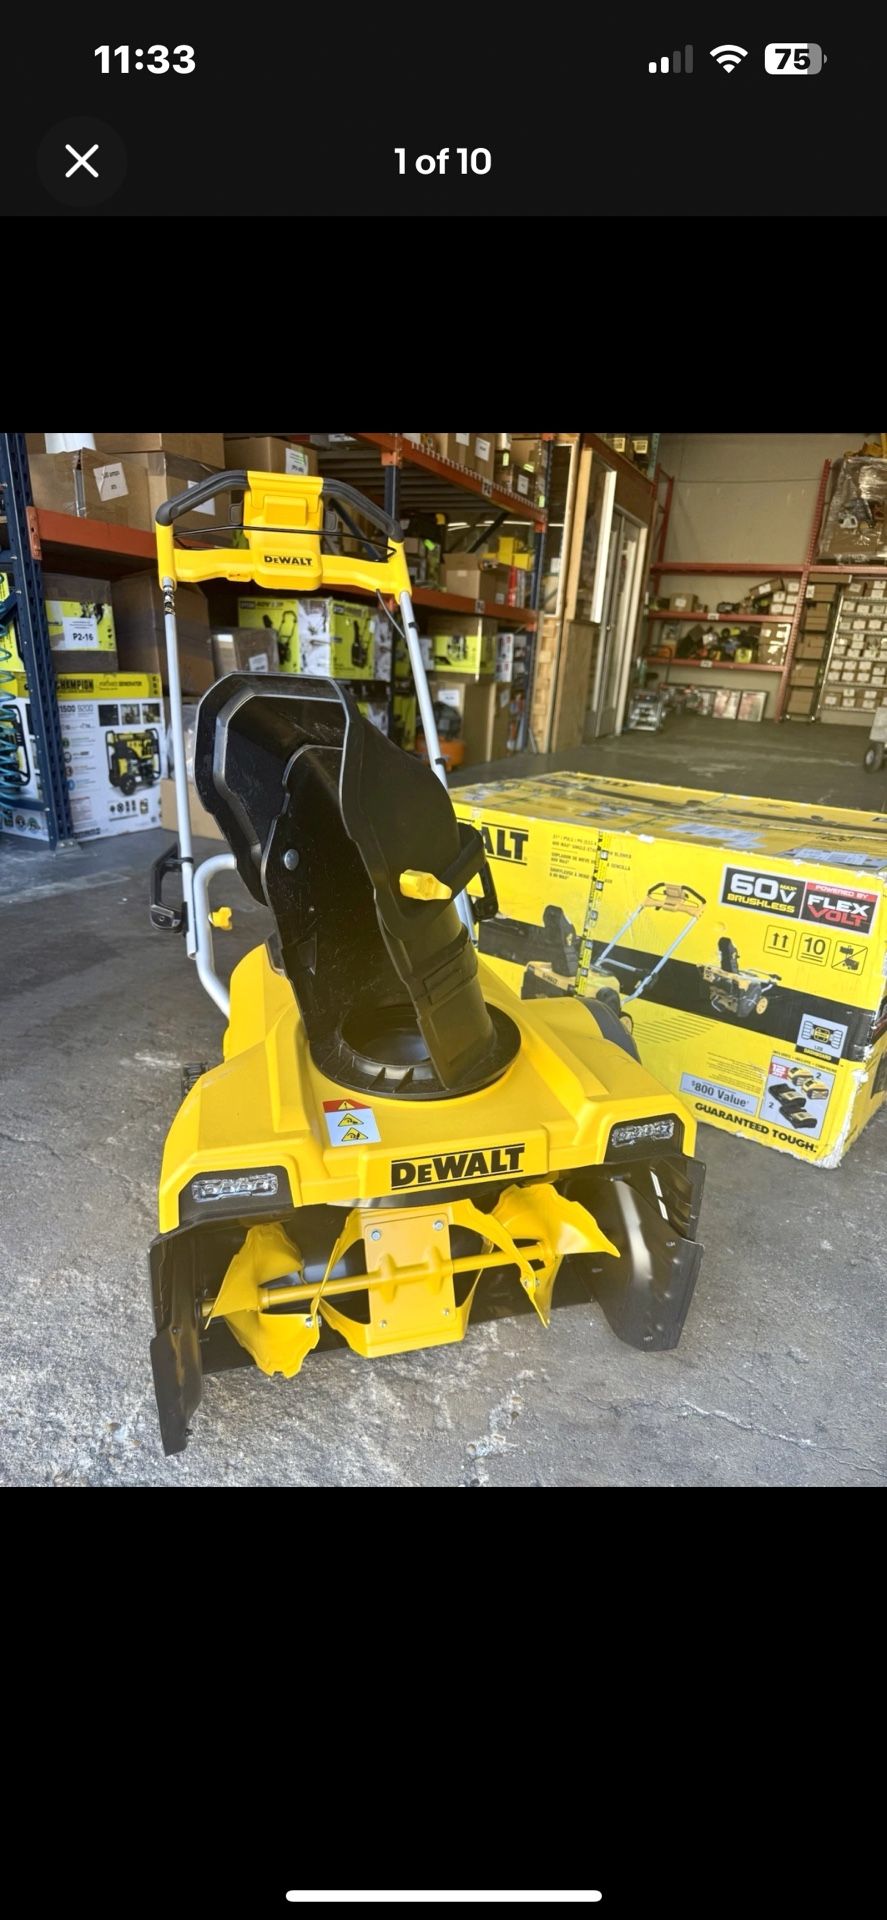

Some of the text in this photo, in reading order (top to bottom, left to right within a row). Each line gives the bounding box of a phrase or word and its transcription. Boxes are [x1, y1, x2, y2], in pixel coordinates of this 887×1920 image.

[72, 632, 94, 641] P2-16
[481, 826, 529, 861] ALT
[815, 884, 870, 900] POWERED BY
[727, 893, 796, 914] BRUSHLESS
[807, 894, 871, 917] FLEX
[808, 906, 868, 927] VOLT
[804, 937, 826, 956] 10
[815, 1072, 822, 1080] 2
[691, 1079, 715, 1097] $800
[768, 1101, 775, 1109] 2
[694, 1102, 770, 1135] GUARANTEED
[391, 1146, 525, 1188] DEWALT
